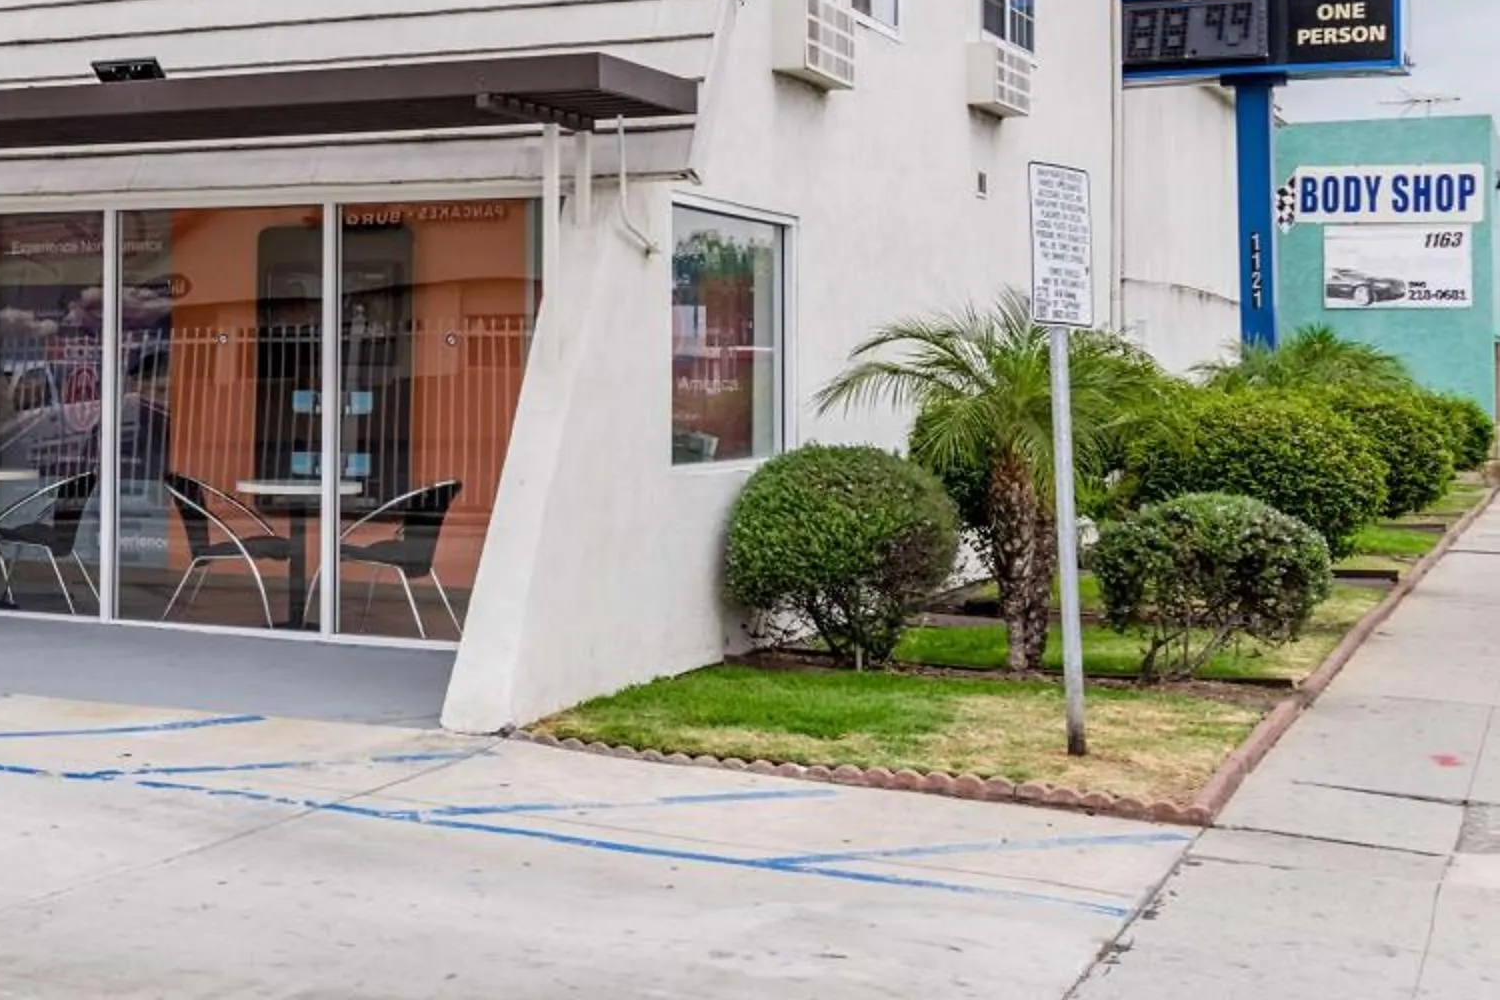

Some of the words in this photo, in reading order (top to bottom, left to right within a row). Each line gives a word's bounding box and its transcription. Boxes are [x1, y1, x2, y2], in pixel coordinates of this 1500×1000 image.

[1316, 2, 1366, 21] ONE
[1297, 25, 1386, 46] PERSON
[1300, 175, 1381, 214] BODY
[1391, 173, 1476, 213] SHOP
[1424, 232, 1464, 249] 1163
[1251, 232, 1262, 309] 1121
